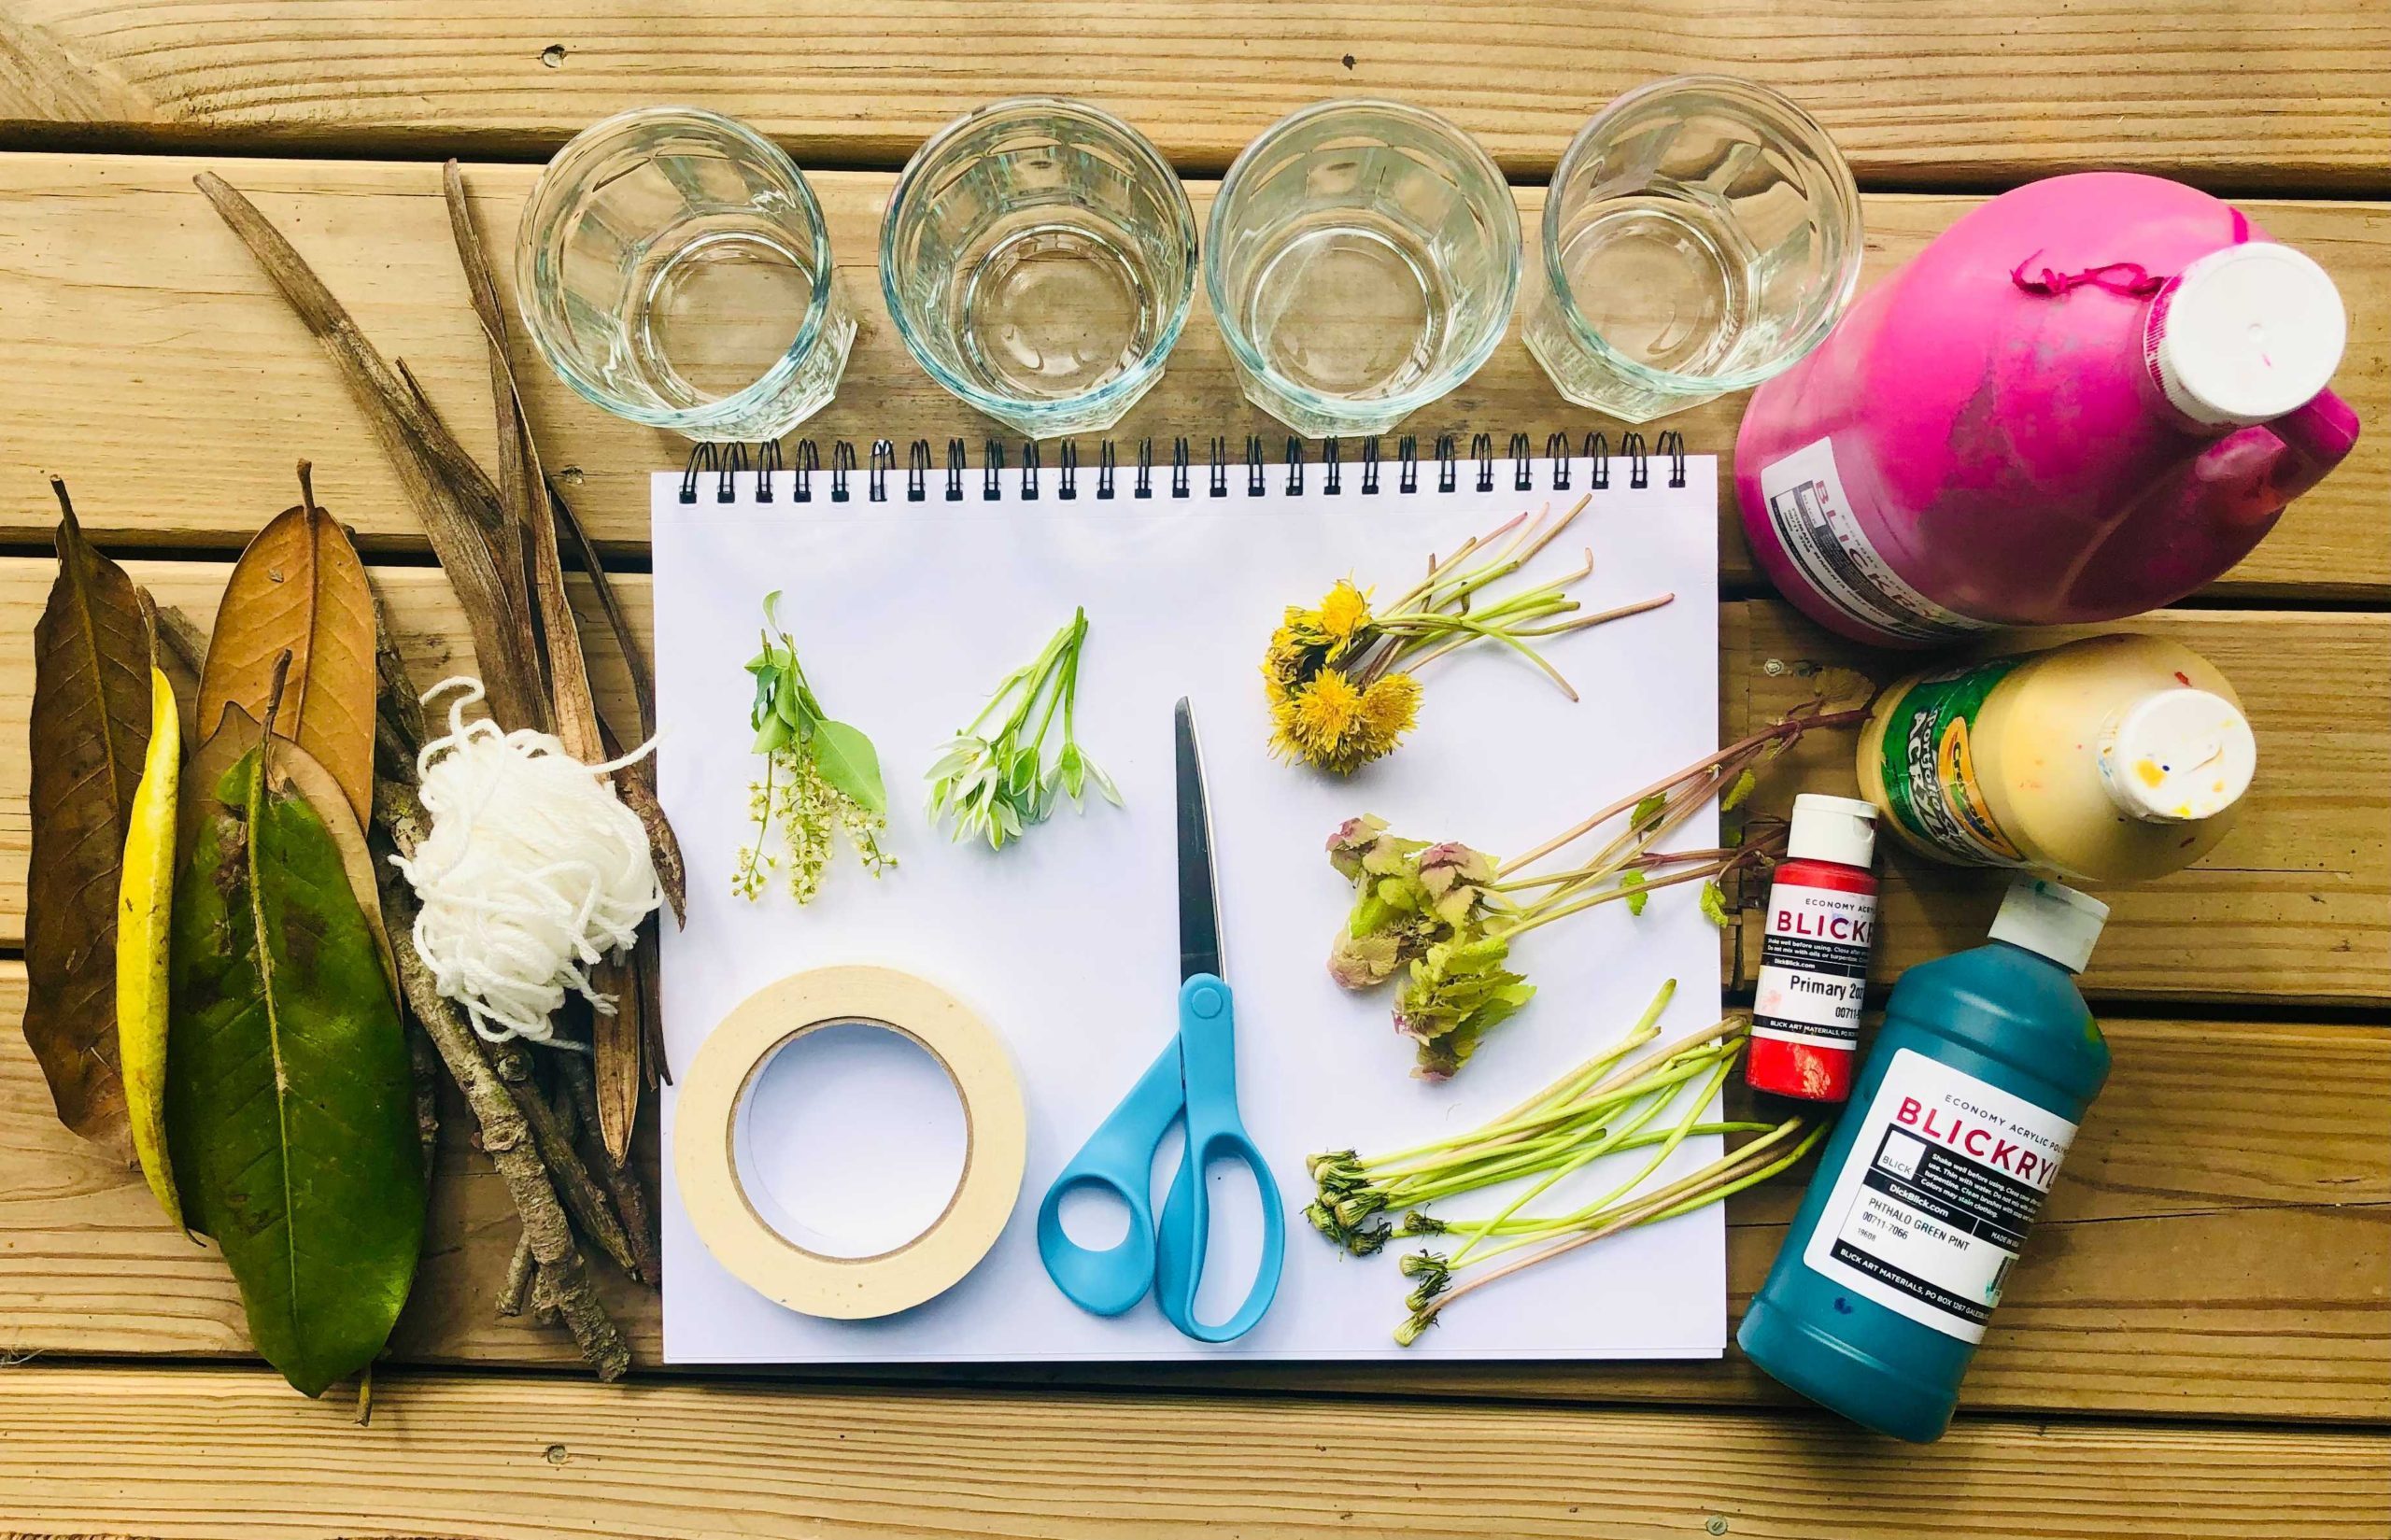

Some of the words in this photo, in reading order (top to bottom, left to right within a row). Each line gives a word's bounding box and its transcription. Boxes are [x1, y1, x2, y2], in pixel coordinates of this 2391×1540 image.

[1920, 708, 1942, 812] Portfolio
[1805, 898, 1855, 911] ECONOMY
[1774, 957, 1816, 969] DickBlick.com
[1792, 940, 1812, 949] before
[1833, 946, 1849, 954] Close
[1790, 975, 1846, 1001] Primary
[1770, 1020, 1788, 1030] BLICK
[1788, 1022, 1804, 1032] ART
[1804, 1024, 1840, 1037] MATERIALS,
[1945, 1094, 2006, 1126] ECONOMY
[2009, 1123, 2049, 1147] ACRYLIC
[1896, 1096, 2058, 1189] BLICKRYL
[1882, 1155, 1913, 1175] BLICK
[1931, 1152, 1953, 1167] Shake
[1953, 1163, 1967, 1174] well
[1967, 1168, 1988, 1183] before
[1988, 1179, 2005, 1192] using.
[2005, 1187, 2020, 1198] Close
[1889, 1183, 1949, 1218] DickBlick.com
[1920, 1178, 1943, 1194] Colors
[1943, 1189, 1959, 1201] may
[1958, 1194, 1974, 1208] stain
[1974, 1201, 1999, 1219] clothing.
[1924, 1169, 1960, 1192] turpentine.
[1960, 1187, 1980, 1200] Clean
[1979, 1194, 2002, 1210] brushes
[2002, 1203, 2014, 1215] with
[1928, 1162, 1942, 1173] use.
[1943, 1168, 1959, 1180] Thin
[1959, 1176, 1974, 1187] with
[1974, 1182, 1992, 1195] water.
[1992, 1191, 2002, 1200] Do
[2002, 1195, 2012, 1205] not
[1857, 1226, 1877, 1242] 19608
[1861, 1210, 1909, 1240] 00711-7066
[1868, 1197, 1913, 1224] PHTHALO
[1914, 1219, 1947, 1241] GREEN
[1947, 1235, 1971, 1251] PINT
[1990, 1231, 2006, 1244] MADE
[1840, 1248, 1862, 1264] BLICK
[1861, 1259, 1879, 1272] ART
[1878, 1267, 1924, 1295] MATERIALS,
[1924, 1290, 1937, 1299] PO
[1936, 1294, 1952, 1307] BOX
[1952, 1301, 1966, 1311] 1267
